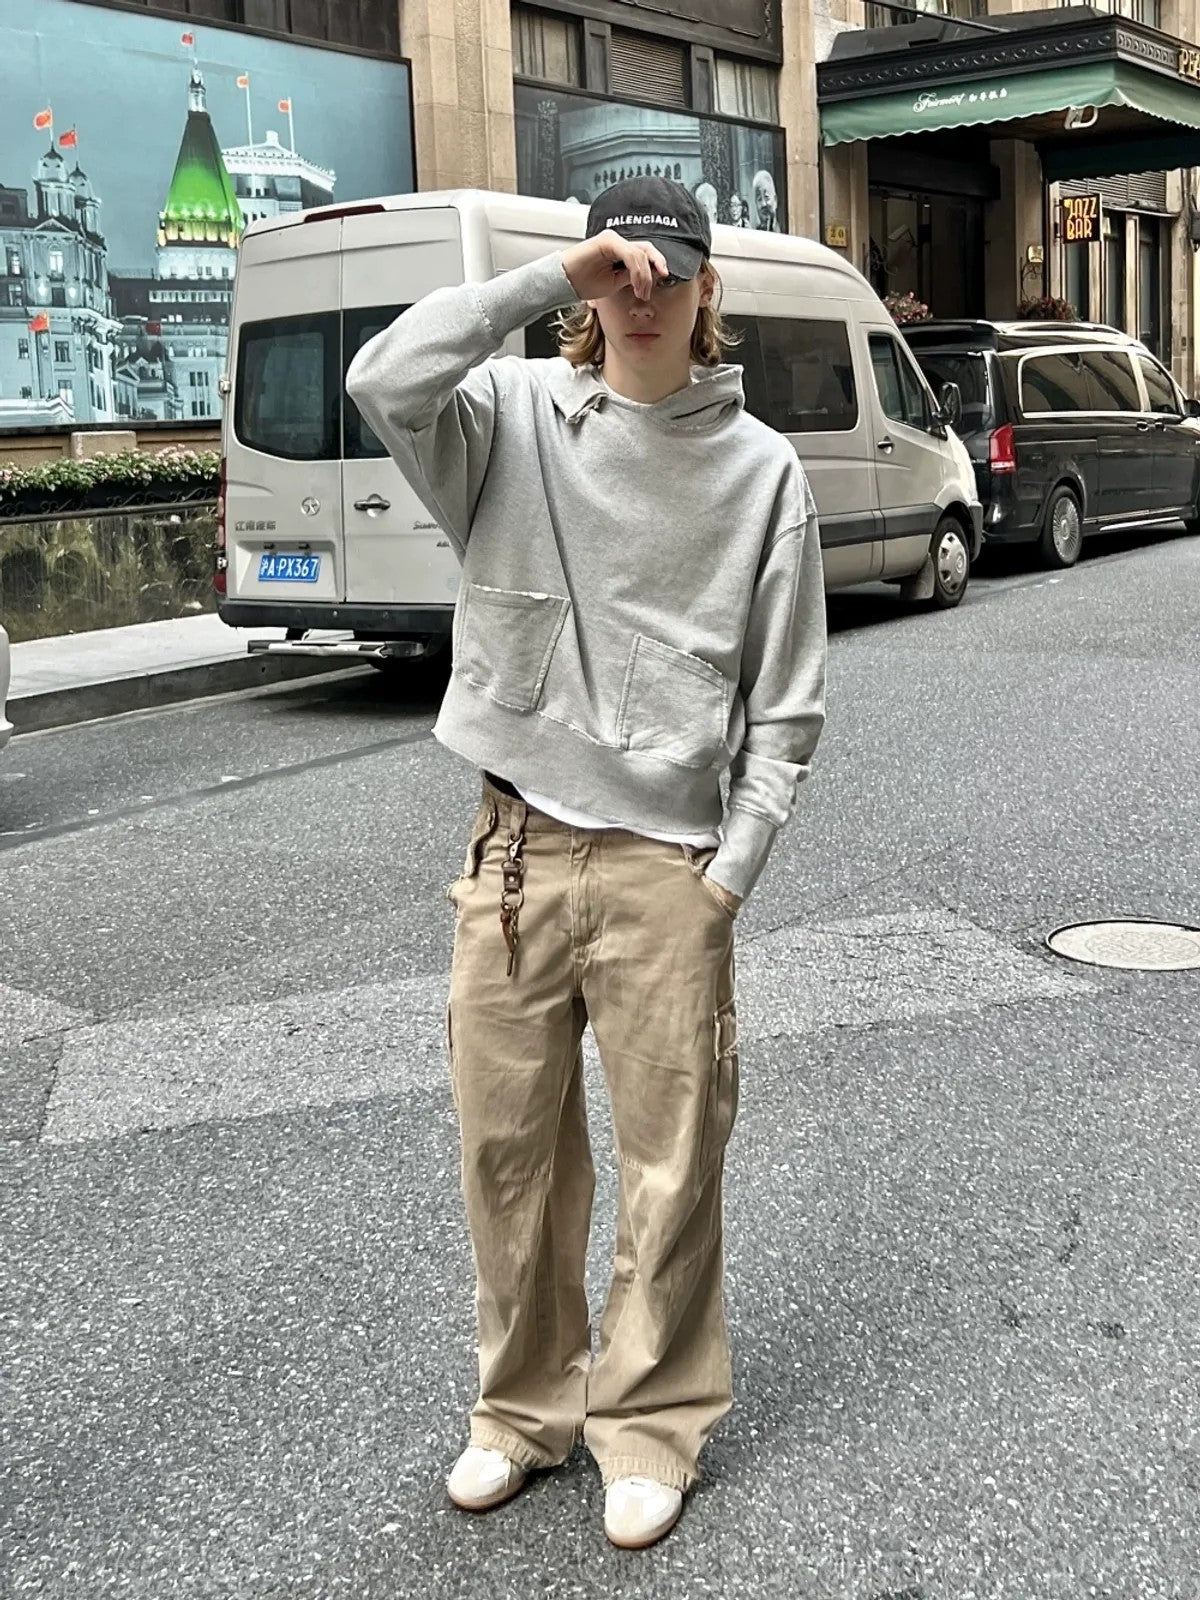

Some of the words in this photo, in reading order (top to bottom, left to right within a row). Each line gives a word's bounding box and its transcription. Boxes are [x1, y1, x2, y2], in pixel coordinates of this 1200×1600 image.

[1064, 197, 1097, 220] JAZZ
[606, 214, 678, 228] BALENCIAGA
[1067, 218, 1092, 240] BAR
